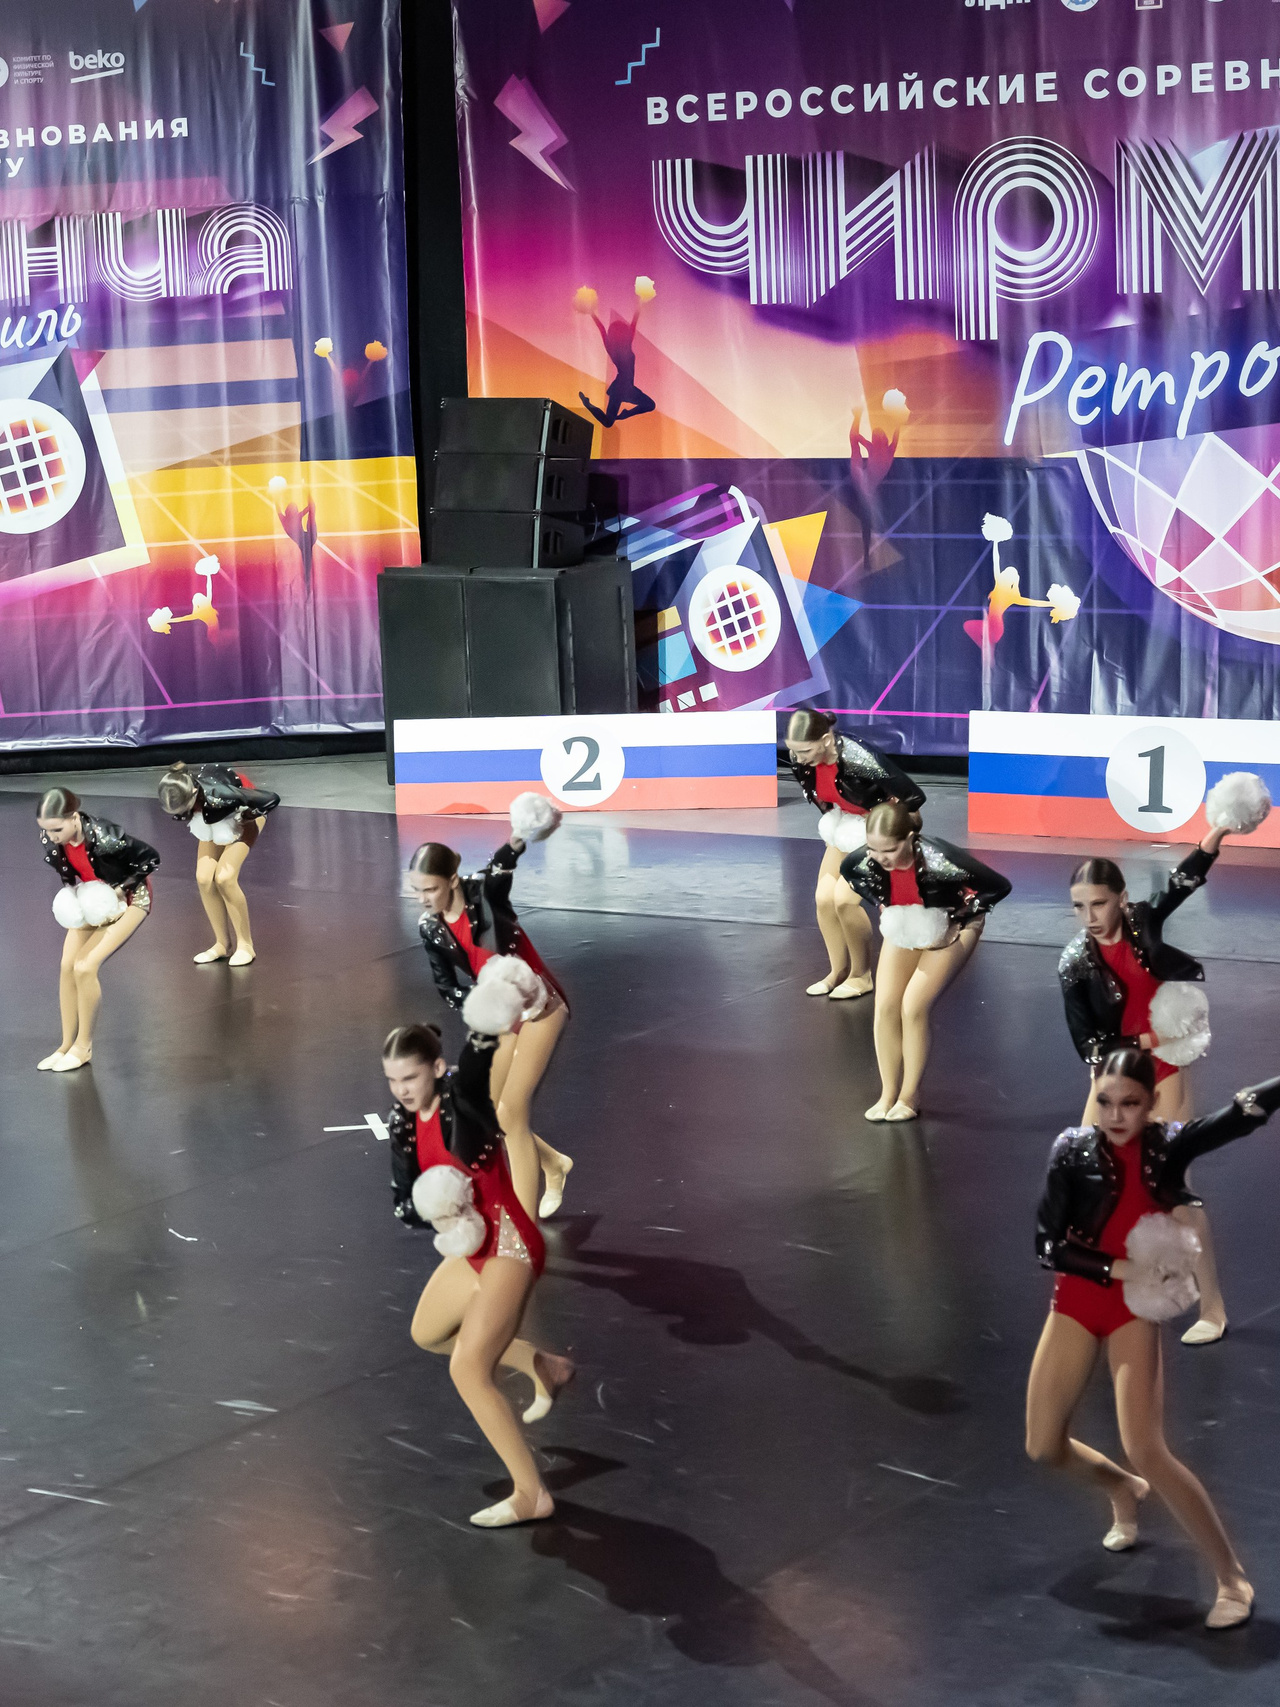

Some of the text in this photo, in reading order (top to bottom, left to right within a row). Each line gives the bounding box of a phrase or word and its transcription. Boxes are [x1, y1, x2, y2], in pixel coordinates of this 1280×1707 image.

[68, 49, 125, 71] beko
[646, 58, 1280, 125] ВСЕРОССИЙСКИЕ СОРЕВН
[1004, 330, 1280, 446] Ретро
[562, 736, 602, 791] 2
[1137, 745, 1173, 813] 1
